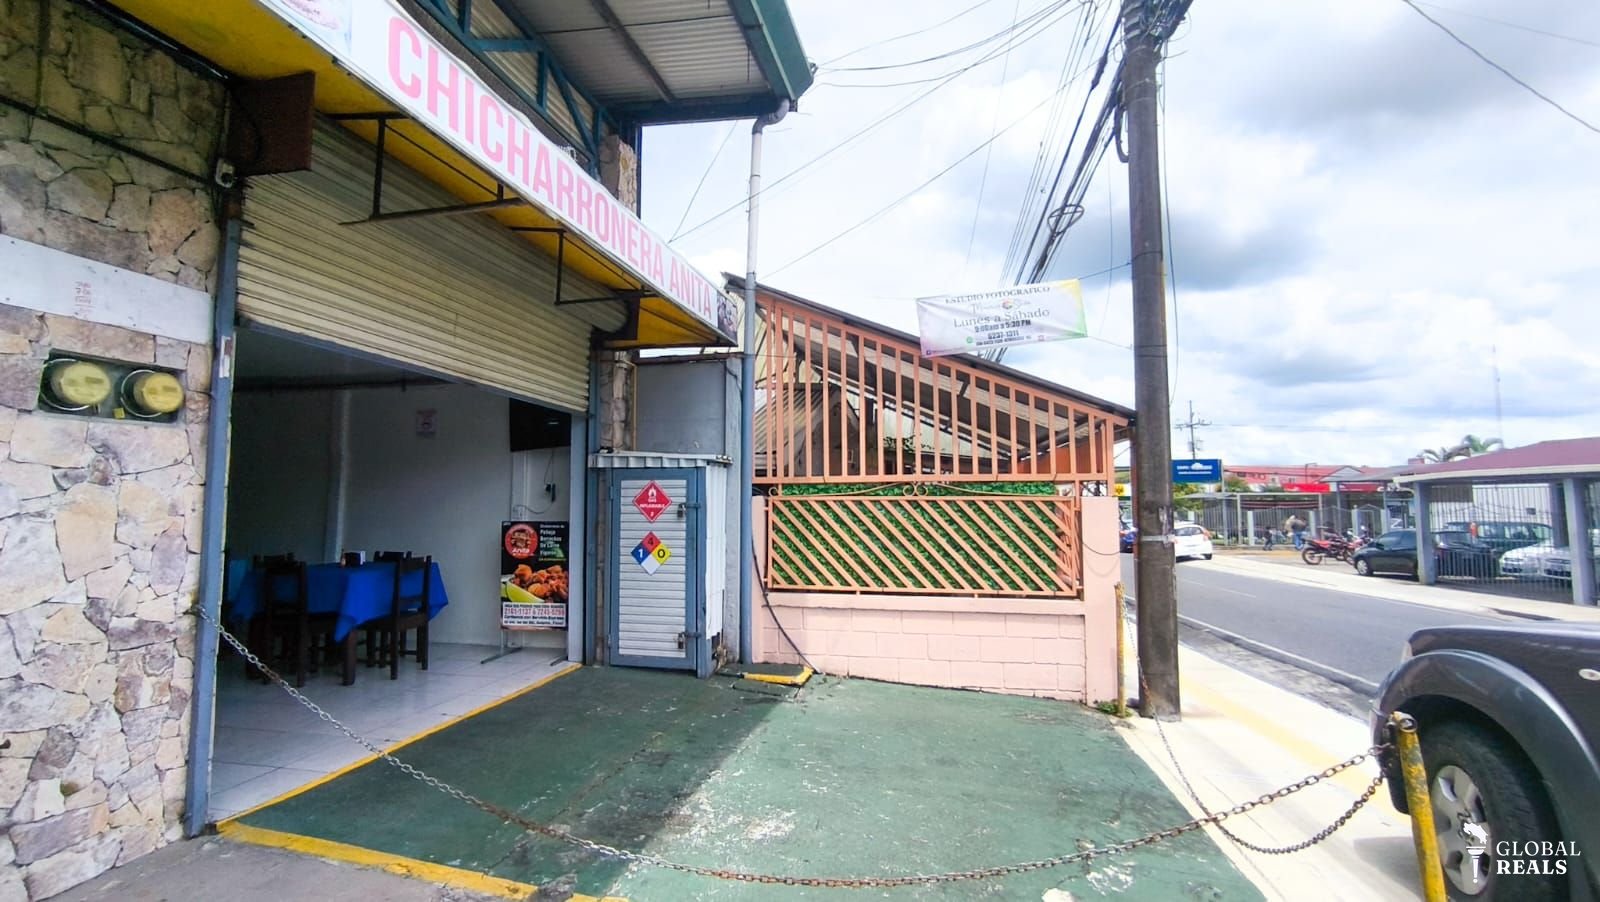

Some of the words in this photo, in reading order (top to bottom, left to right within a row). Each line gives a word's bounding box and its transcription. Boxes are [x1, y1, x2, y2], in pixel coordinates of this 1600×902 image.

[388, 18, 664, 287] CHICHARRONERA
[669, 256, 712, 320] ANITA
[953, 316, 991, 328] Lunes
[648, 538, 654, 546] 4
[639, 549, 643, 558] 1
[658, 549, 665, 558] 0
